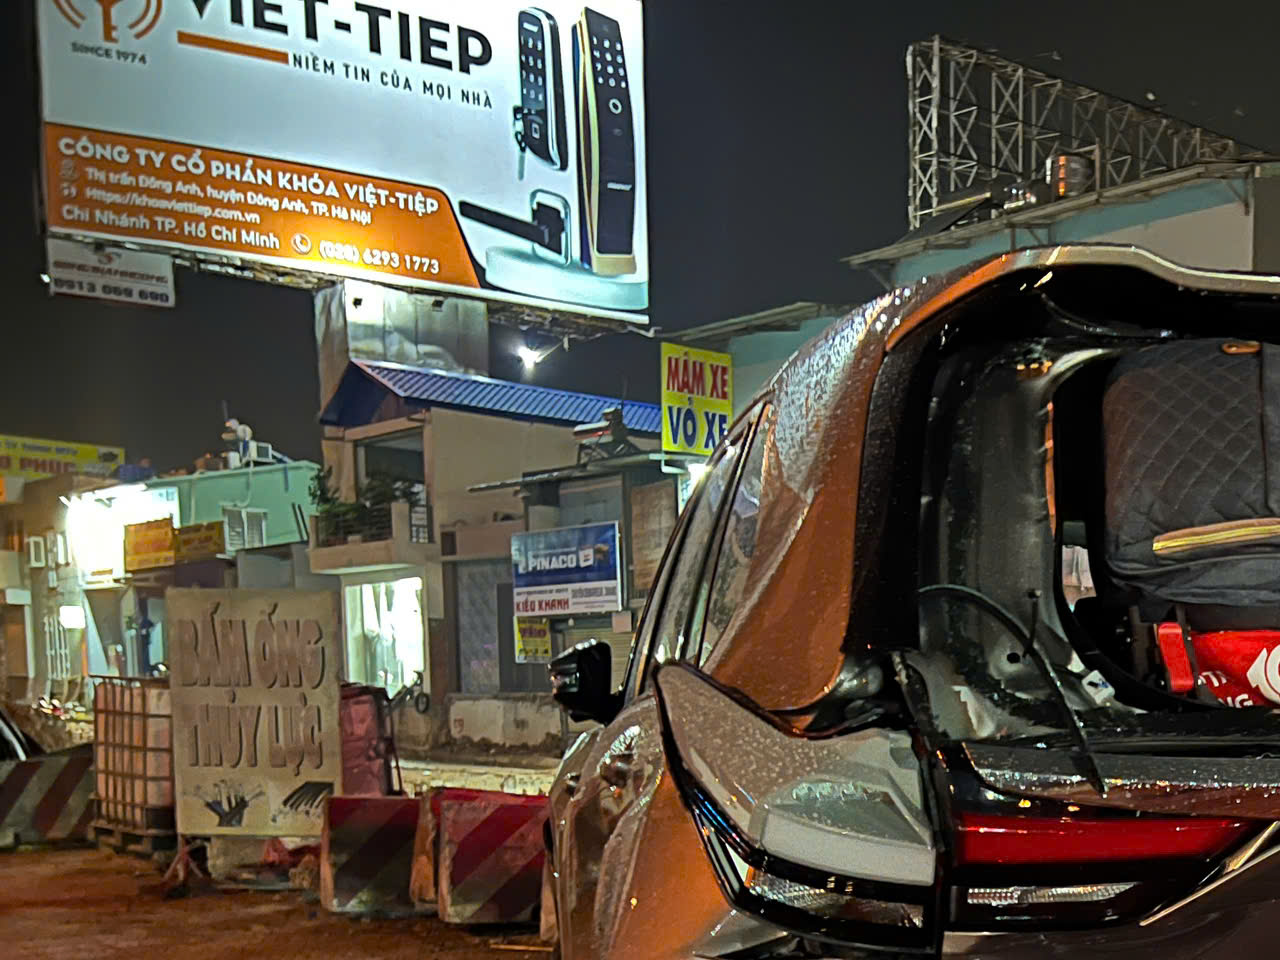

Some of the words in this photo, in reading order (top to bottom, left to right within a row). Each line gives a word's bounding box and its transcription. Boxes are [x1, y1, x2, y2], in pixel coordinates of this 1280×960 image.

[71, 42, 113, 59] SINCE
[116, 50, 147, 65] 1974
[342, 63, 370, 83] TIN
[380, 69, 412, 92] CỦA
[423, 79, 451, 101] MỌI
[461, 88, 493, 109] NHÀ
[59, 136, 129, 163] CÔNG
[136, 148, 165, 168] TY
[278, 170, 339, 198] KHÓA
[344, 182, 439, 216] VIỆT-TIỆP
[281, 196, 309, 215] Anh,
[362, 247, 400, 268] 6293
[404, 254, 440, 274] 1773
[709, 363, 729, 400] XE
[668, 396, 697, 448] VỎ
[528, 552, 577, 572] PINACO
